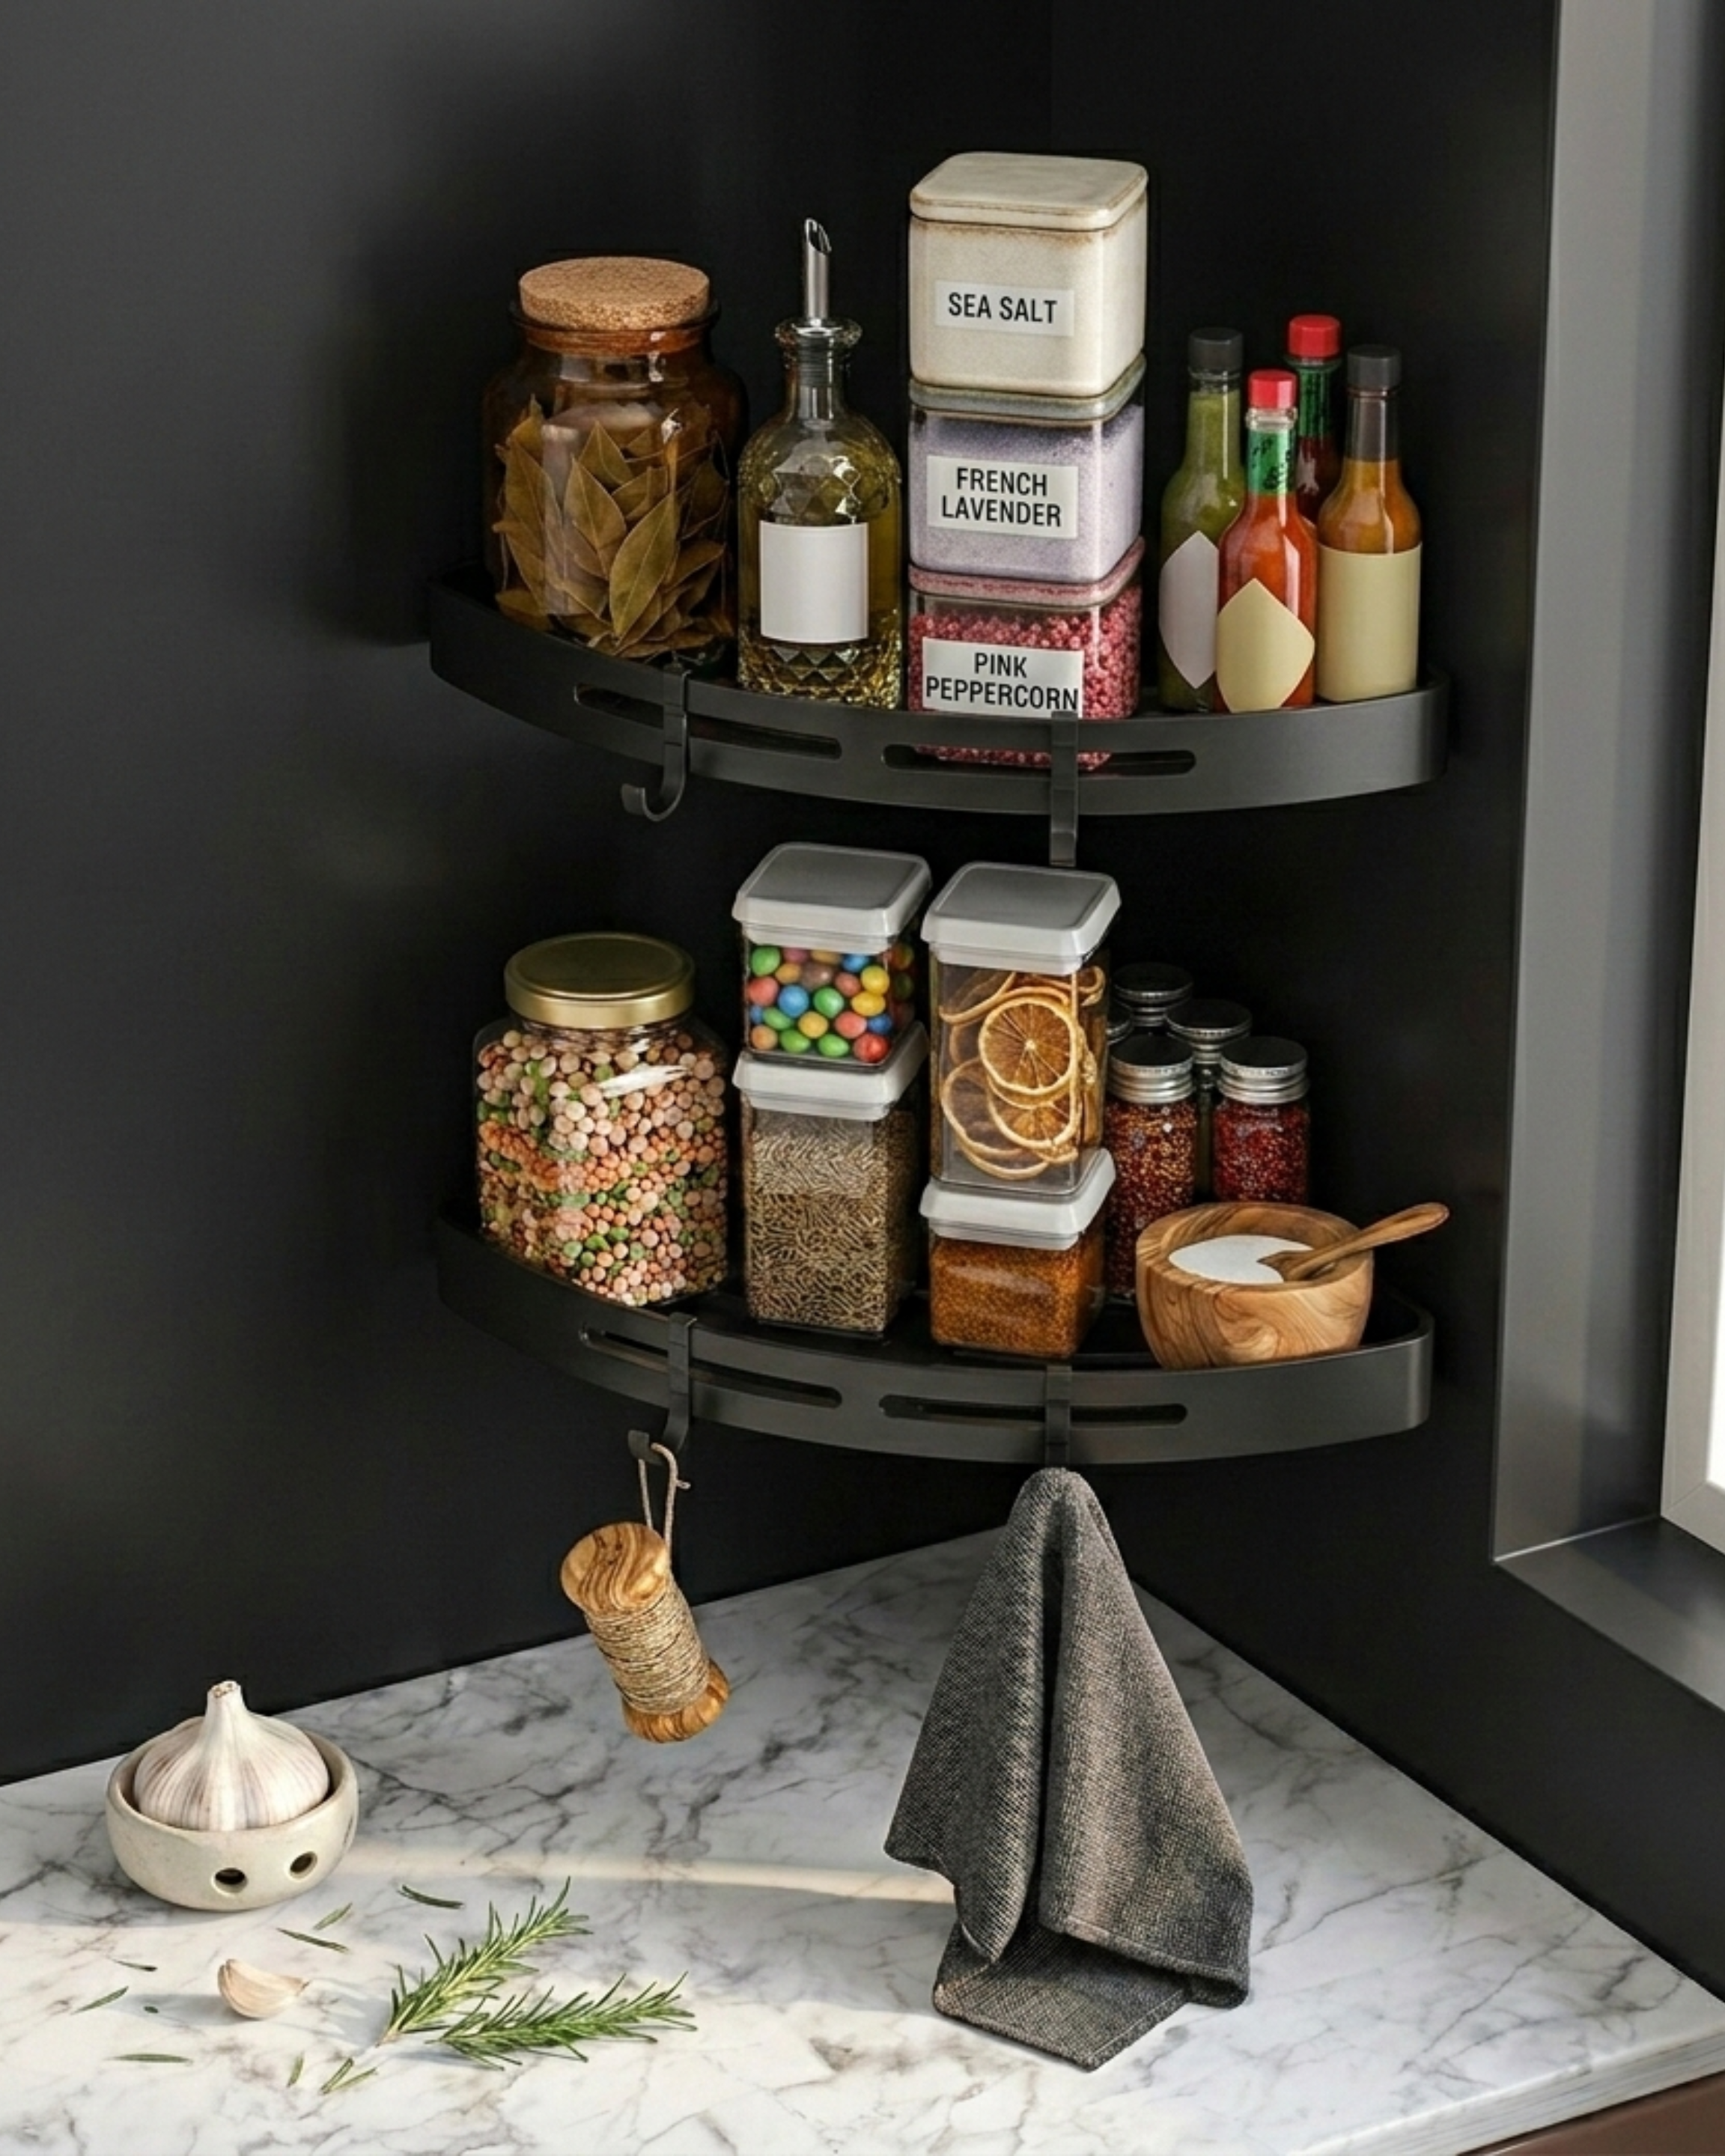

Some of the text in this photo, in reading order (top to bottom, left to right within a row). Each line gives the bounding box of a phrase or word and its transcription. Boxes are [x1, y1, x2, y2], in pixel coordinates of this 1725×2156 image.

[948, 292, 1057, 324] SEA SALT
[957, 467, 1047, 497] FRENCH
[942, 495, 1061, 527] LAVENDER
[974, 652, 1027, 679] PINK
[925, 675, 1078, 710] PEPPERCORN
